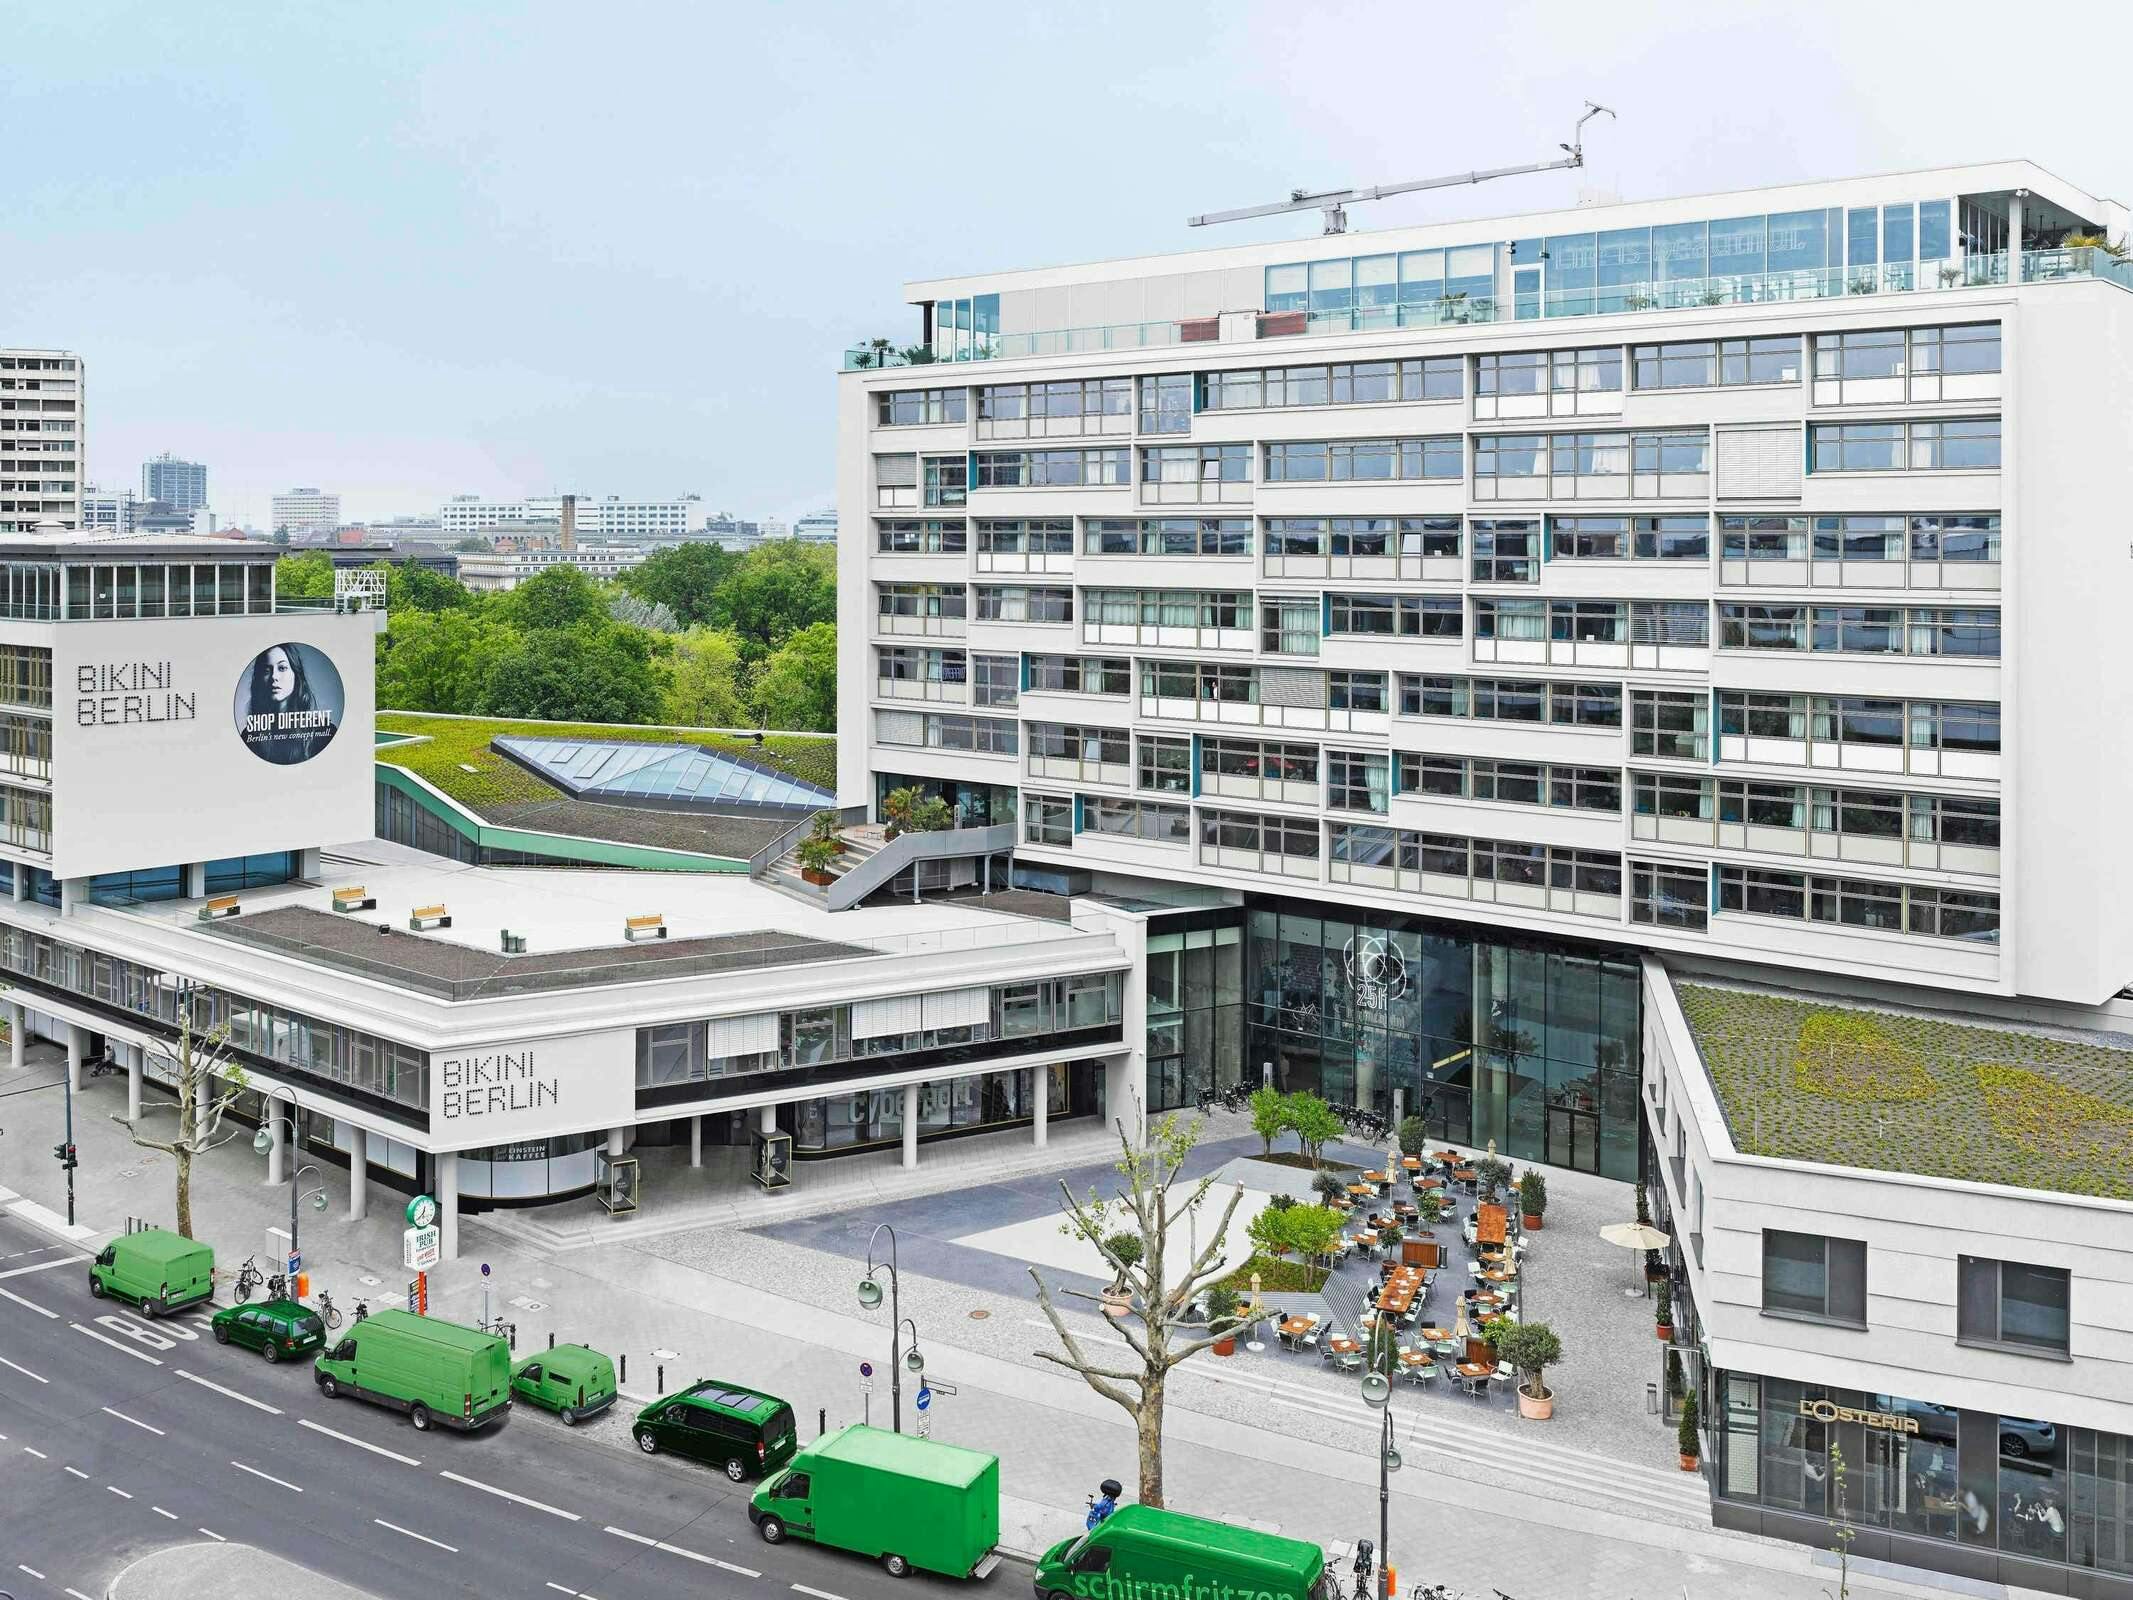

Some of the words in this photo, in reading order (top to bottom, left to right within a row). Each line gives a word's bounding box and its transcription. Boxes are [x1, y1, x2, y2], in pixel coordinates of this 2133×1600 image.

[78, 661, 171, 693] BIKINI
[78, 692, 195, 726] BERLIN
[247, 713, 275, 733] SHOP
[278, 710, 332, 730] DIFFERENT
[246, 732, 272, 743] Berlin's
[274, 733, 287, 741] new
[289, 731, 314, 741] concept
[315, 728, 332, 738] mall.
[444, 1051, 533, 1088] BIKINI
[444, 1079, 558, 1119] BERLIN
[508, 1145, 546, 1154] EINSTEIN
[508, 1152, 546, 1161] KAFFEE
[416, 1230, 436, 1242] IRISH
[419, 1238, 434, 1248] PUB
[1799, 1399, 1920, 1434] L'OSTERIA
